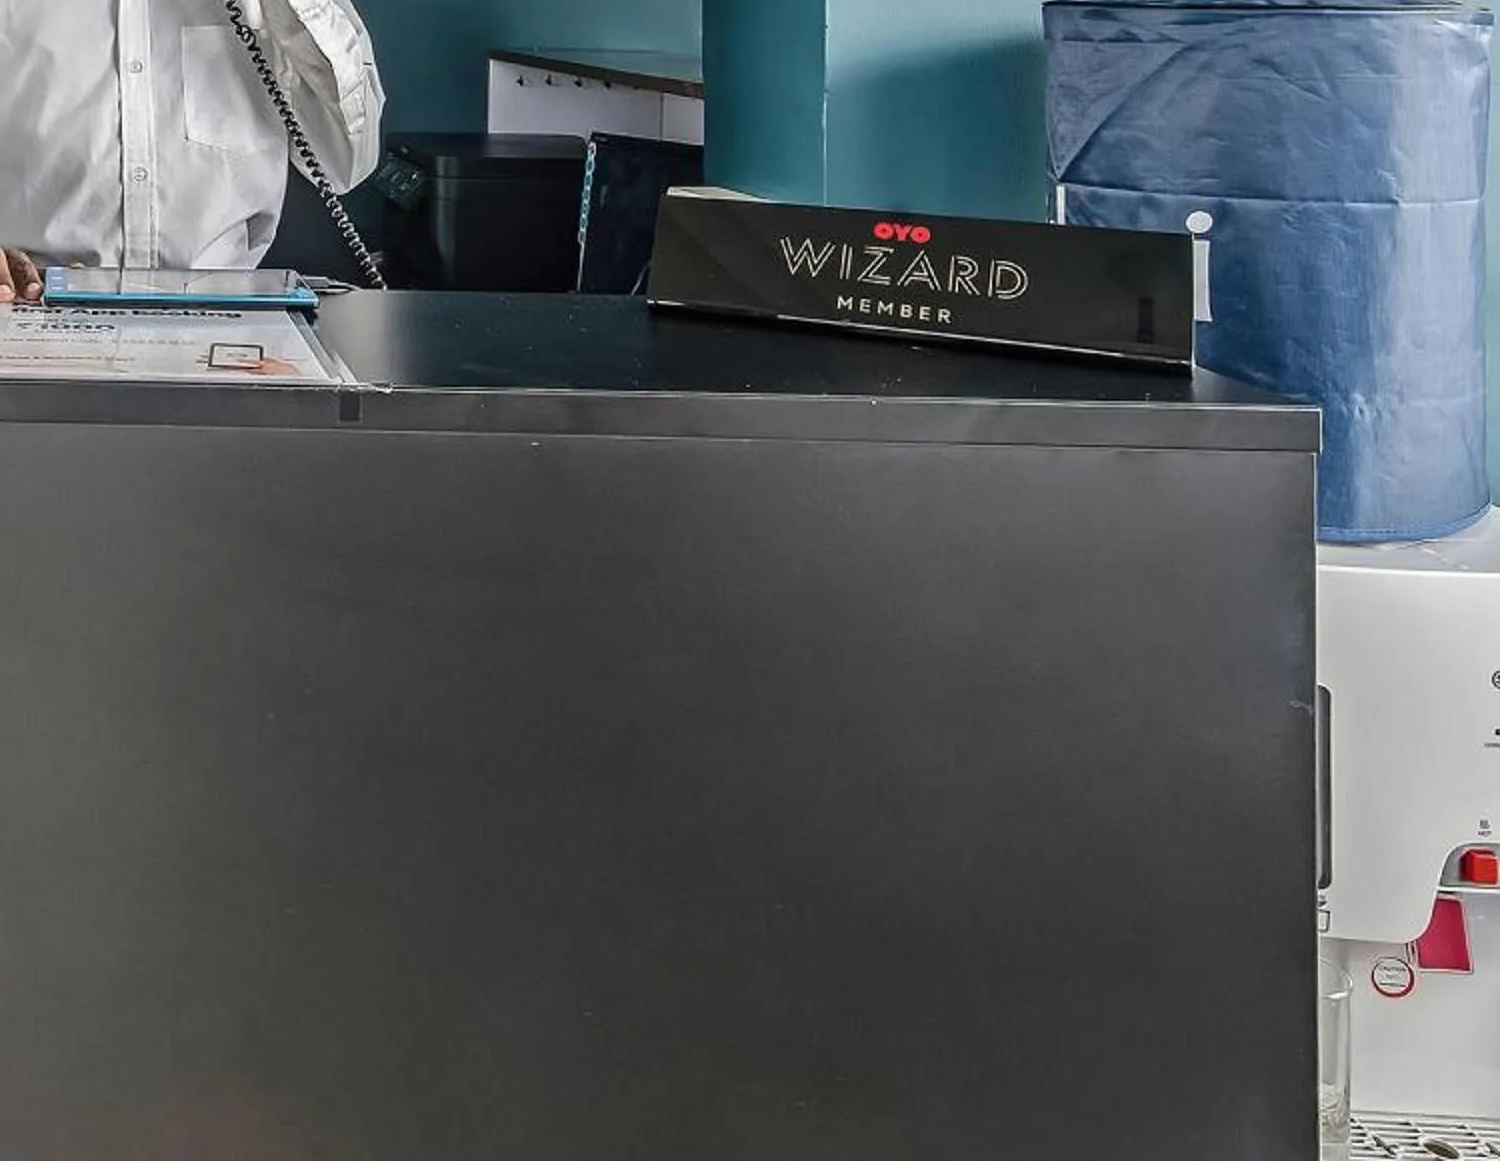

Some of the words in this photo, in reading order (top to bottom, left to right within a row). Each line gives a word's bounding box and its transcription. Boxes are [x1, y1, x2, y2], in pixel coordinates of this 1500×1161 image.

[873, 221, 932, 244] OYO
[779, 236, 1029, 300] WIZARD
[836, 295, 953, 324] MEMBER
